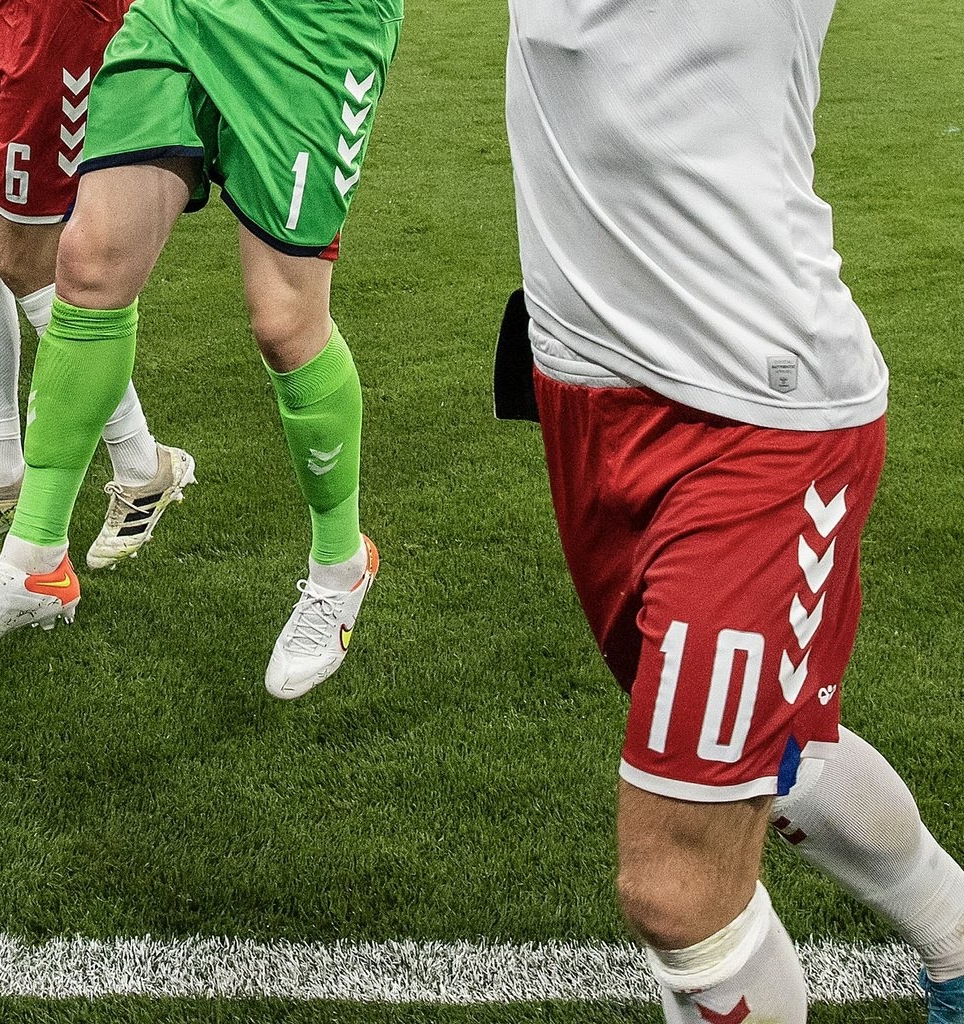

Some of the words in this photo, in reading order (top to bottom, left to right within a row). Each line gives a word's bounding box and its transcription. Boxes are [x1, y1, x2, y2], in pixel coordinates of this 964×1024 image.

[4, 142, 31, 205] 6
[285, 151, 310, 230] 1
[647, 619, 766, 764] 10
